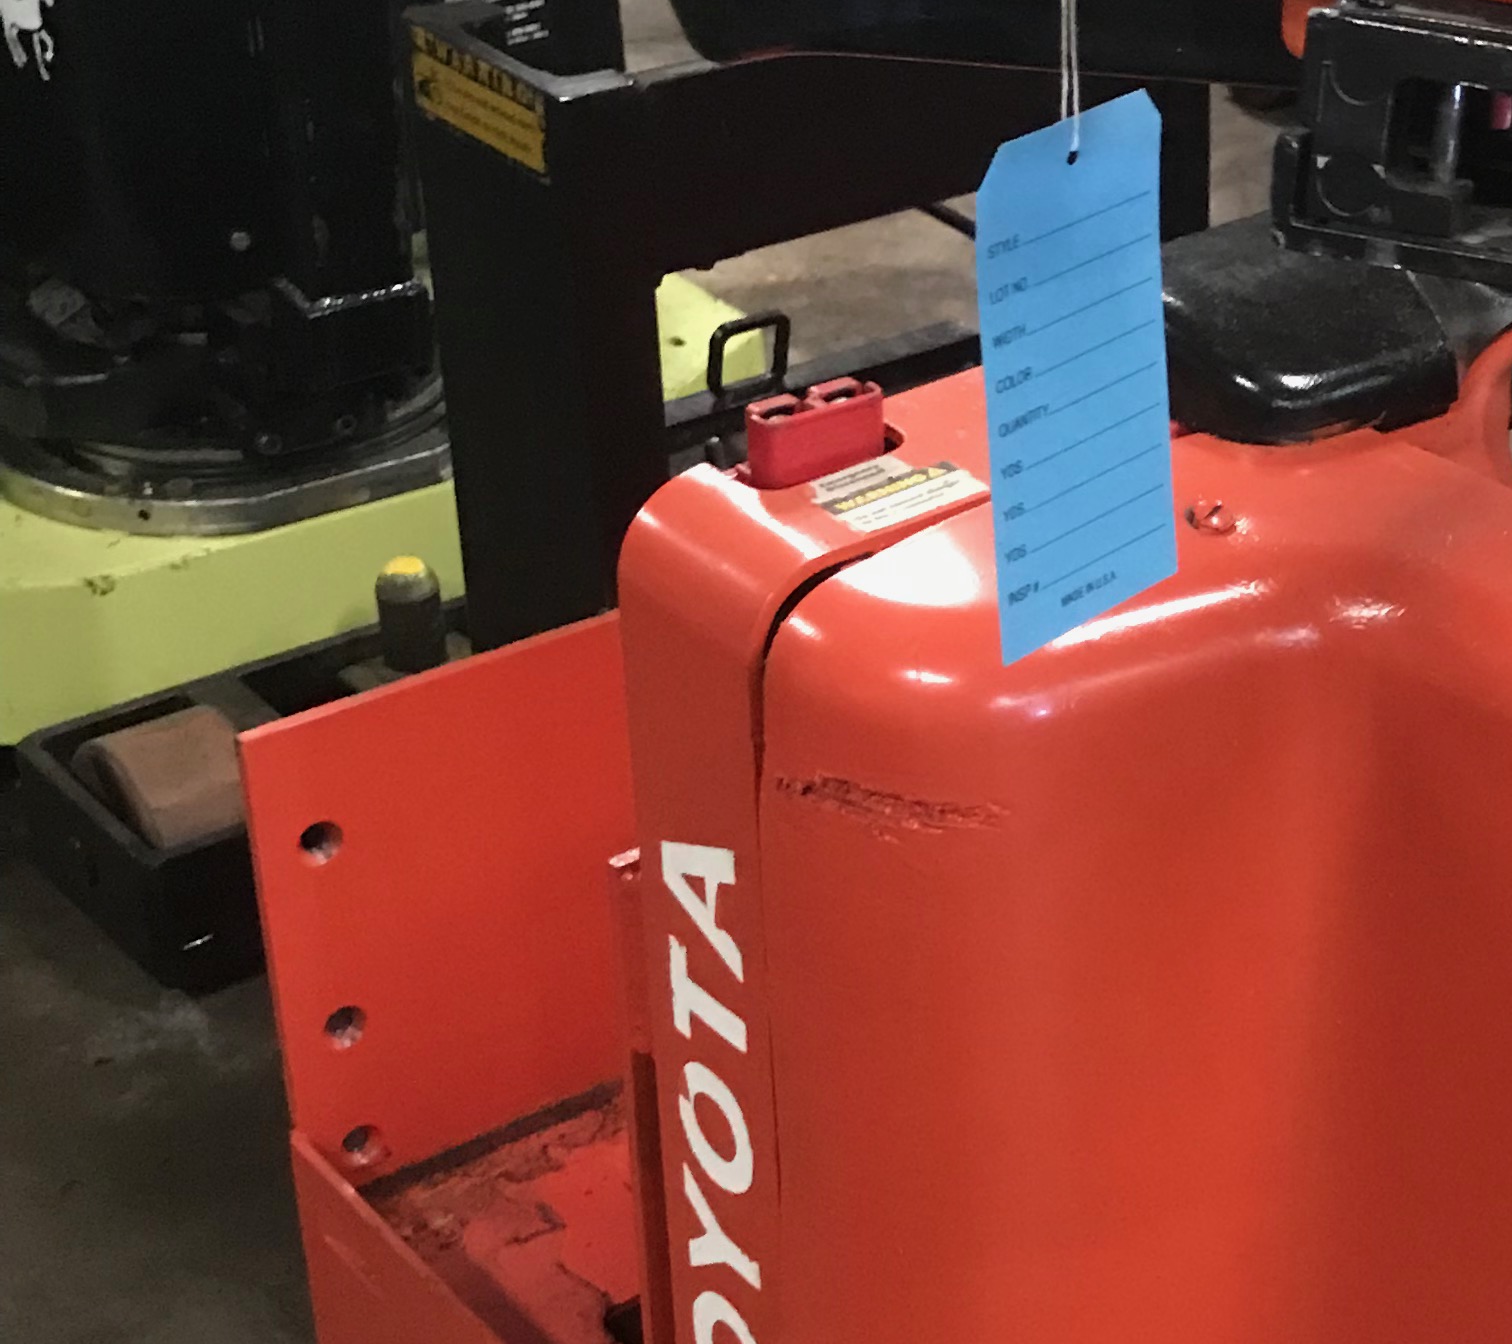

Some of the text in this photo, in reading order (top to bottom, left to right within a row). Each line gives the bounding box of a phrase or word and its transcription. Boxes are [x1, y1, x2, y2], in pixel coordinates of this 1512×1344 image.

[987, 234, 1021, 260] STYLE
[989, 282, 1010, 306] LOT
[995, 366, 1033, 394] COLOR
[998, 403, 1051, 438] QUANTITY
